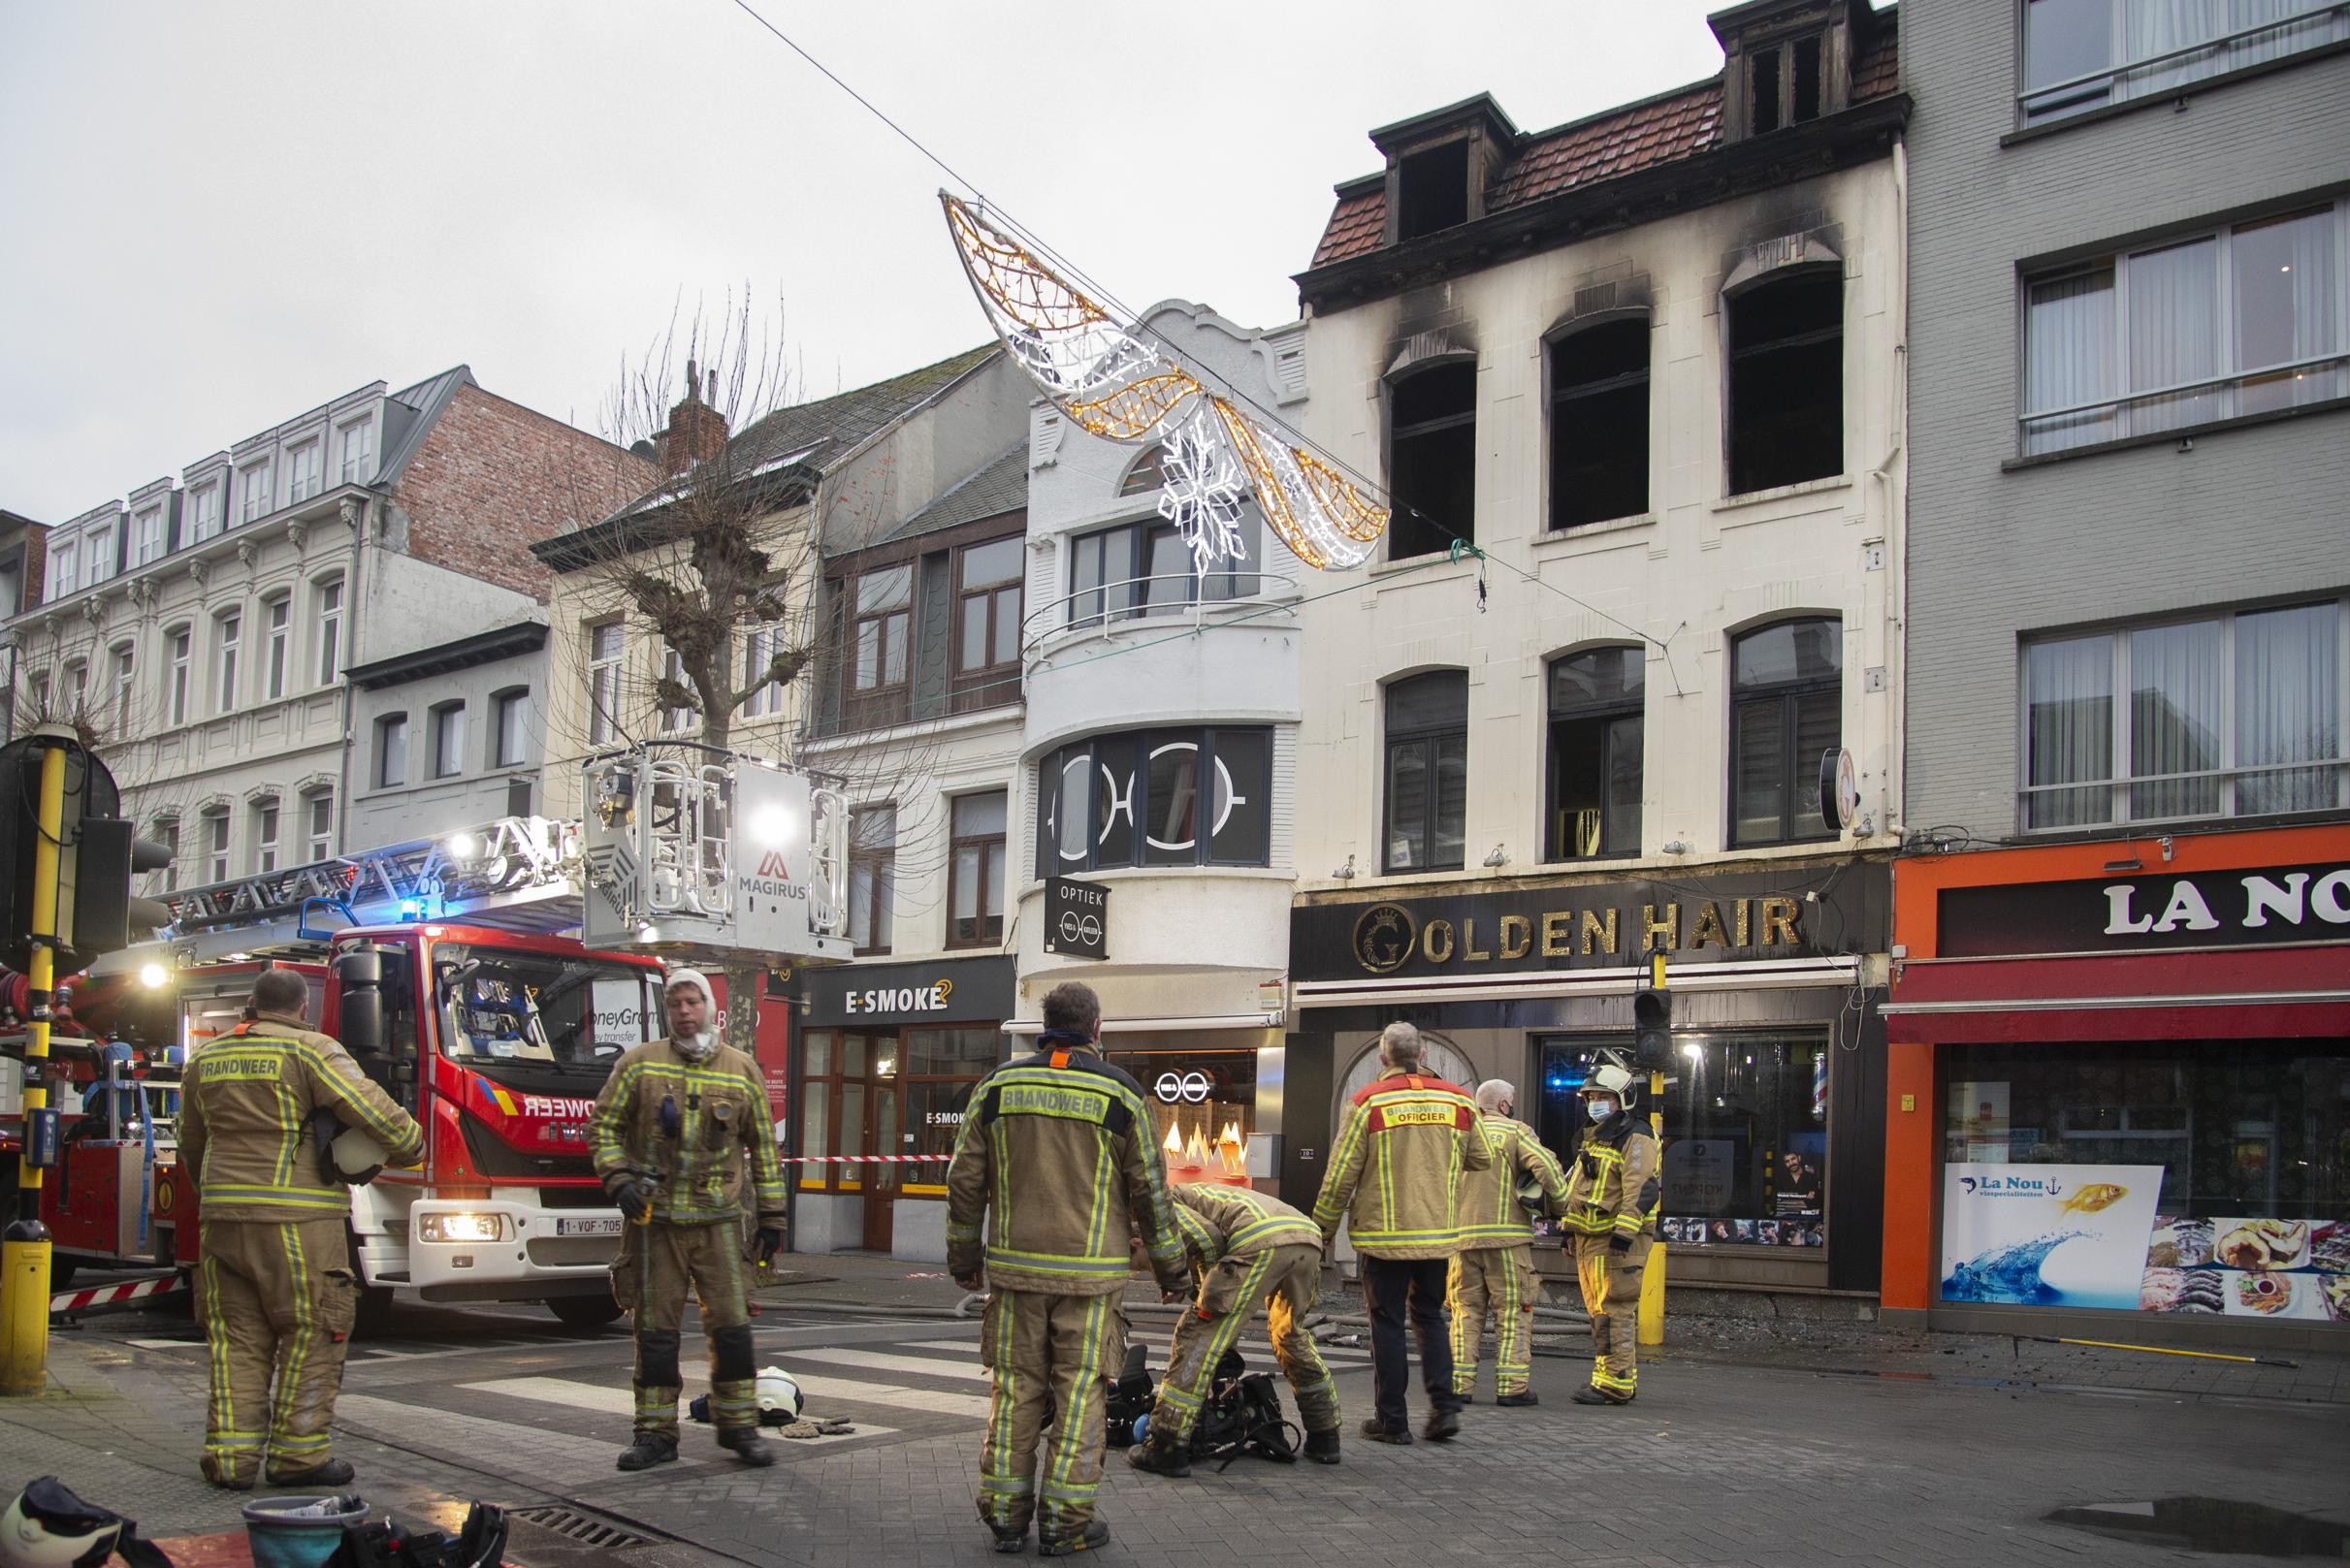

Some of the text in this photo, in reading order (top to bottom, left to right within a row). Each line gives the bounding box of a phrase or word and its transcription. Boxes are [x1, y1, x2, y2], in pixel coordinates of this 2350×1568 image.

[740, 877, 806, 900] MAGIRUS
[1060, 885, 1103, 906] OPTIEK
[2104, 880, 2219, 935] LA
[1363, 898, 1803, 966] GOLDEN HAIR
[200, 1058, 277, 1078] BRANDWEER
[1003, 1089, 1104, 1118] BRANDWEER
[926, 1112, 966, 1124] E-SMOK
[1980, 1176, 2044, 1189] La Nou
